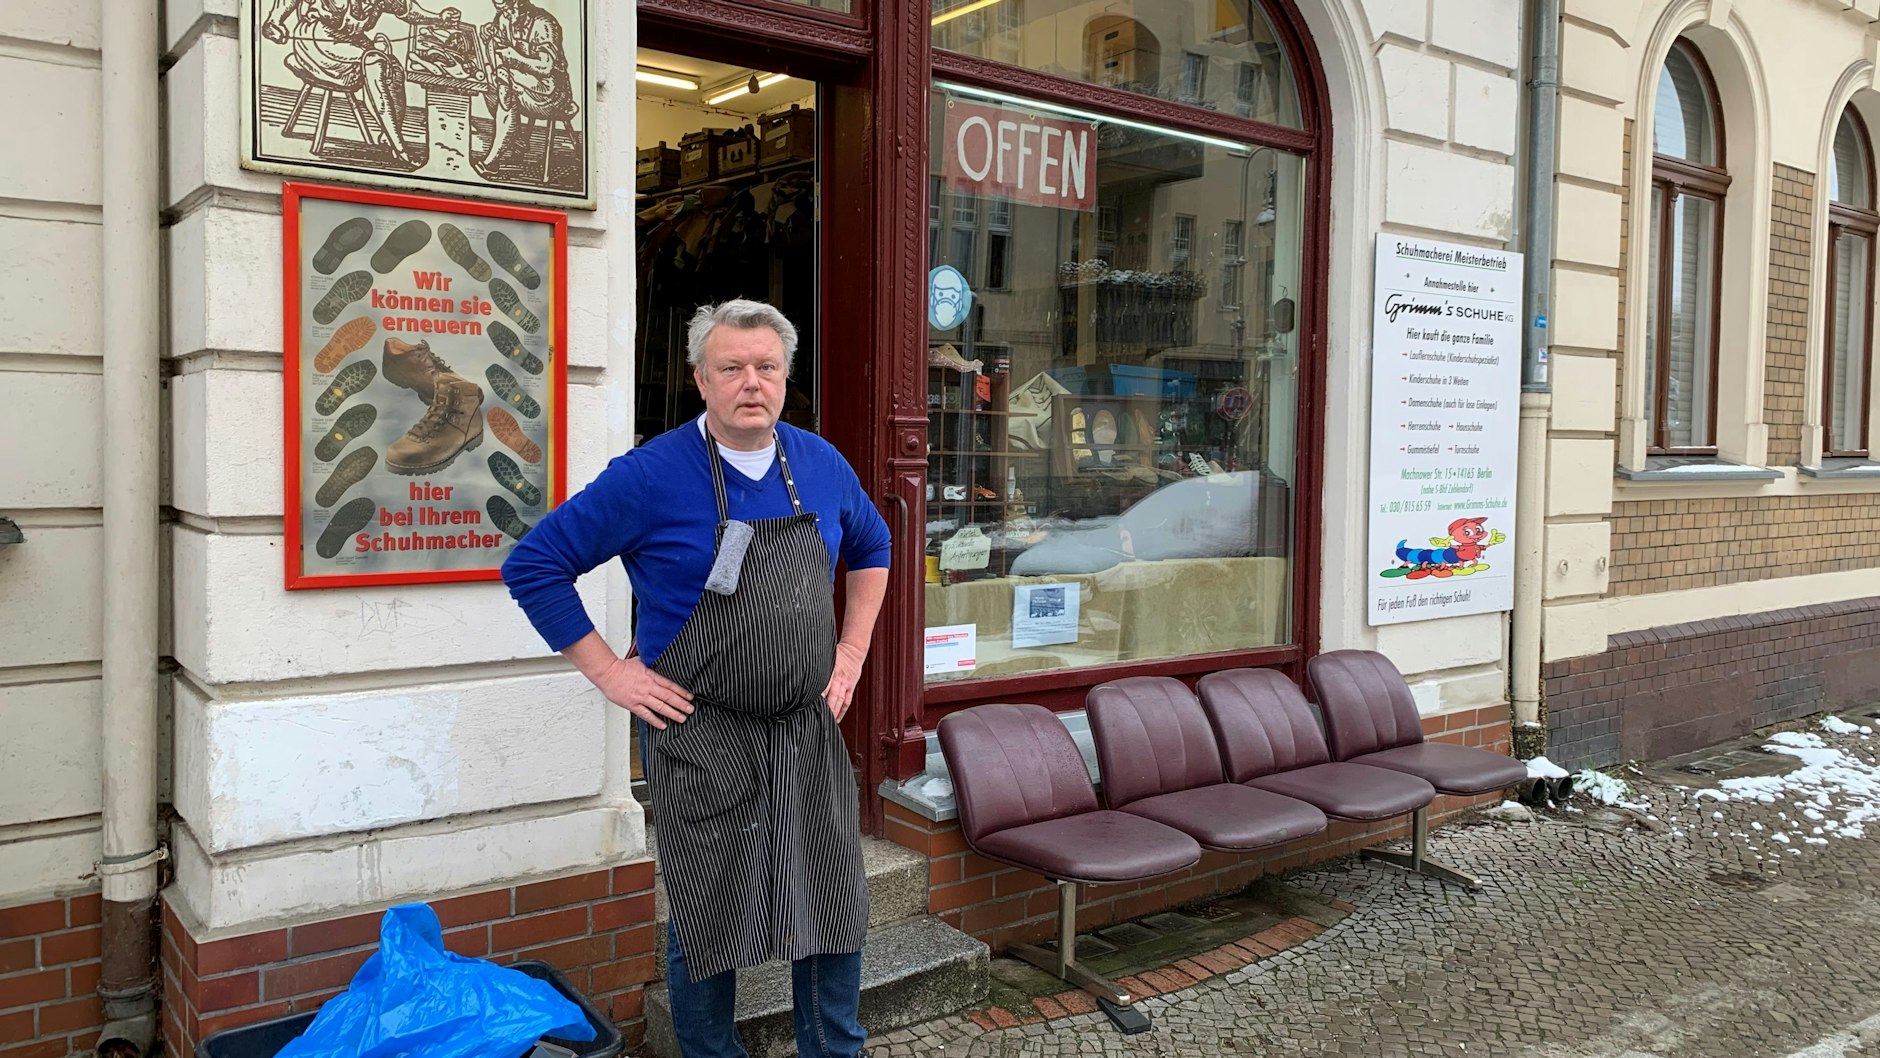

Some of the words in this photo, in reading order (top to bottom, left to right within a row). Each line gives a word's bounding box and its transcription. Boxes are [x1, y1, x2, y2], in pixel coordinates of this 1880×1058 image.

[957, 116, 1088, 199] OFFEN
[1396, 242, 1452, 262] Schuhmacherei
[1454, 251, 1506, 269] Meisterbetrieb
[413, 271, 453, 292] Wir
[1424, 276, 1466, 292] Annahmestelle
[1467, 282, 1479, 293] hier
[371, 289, 453, 313] können
[460, 295, 492, 316] sie
[1385, 294, 1454, 323] Grimm's
[1456, 306, 1504, 321] SCHUHE
[1505, 314, 1514, 322] KG
[382, 317, 482, 336] erneuern
[1406, 328, 1421, 339] Hier
[1422, 328, 1440, 341] kauft
[1441, 330, 1450, 342] die
[1452, 334, 1470, 345] ganze
[1472, 333, 1494, 345] Familie
[1410, 350, 1446, 362] Lauflernschuhe
[1409, 373, 1441, 384] Kinderschuhe
[1442, 376, 1447, 385] in
[1448, 376, 1452, 385] 3
[1453, 376, 1469, 386] Weiten
[1408, 397, 1442, 408] Damenschuhe
[1443, 398, 1456, 409] (auch
[1466, 398, 1475, 409] lose
[1476, 399, 1498, 412] Einlagen)
[1408, 420, 1441, 431] Herrenschuhe
[1456, 422, 1483, 431] Hausschuhe
[1407, 444, 1440, 454] Gummistiefel
[1454, 444, 1479, 454] Turnschuhe
[1400, 468, 1433, 480] Machnower
[1477, 467, 1492, 479] Berlin
[409, 481, 454, 501] hier
[380, 506, 412, 526] bei
[419, 508, 481, 526] Ihrem
[355, 530, 503, 552] Schuhmacher
[1378, 598, 1387, 612] Für
[1388, 596, 1405, 613] jeden
[1406, 594, 1417, 608] Fuß
[1418, 594, 1428, 607] den
[1429, 592, 1452, 607] richtigen
[1454, 589, 1471, 602] Schuh!
